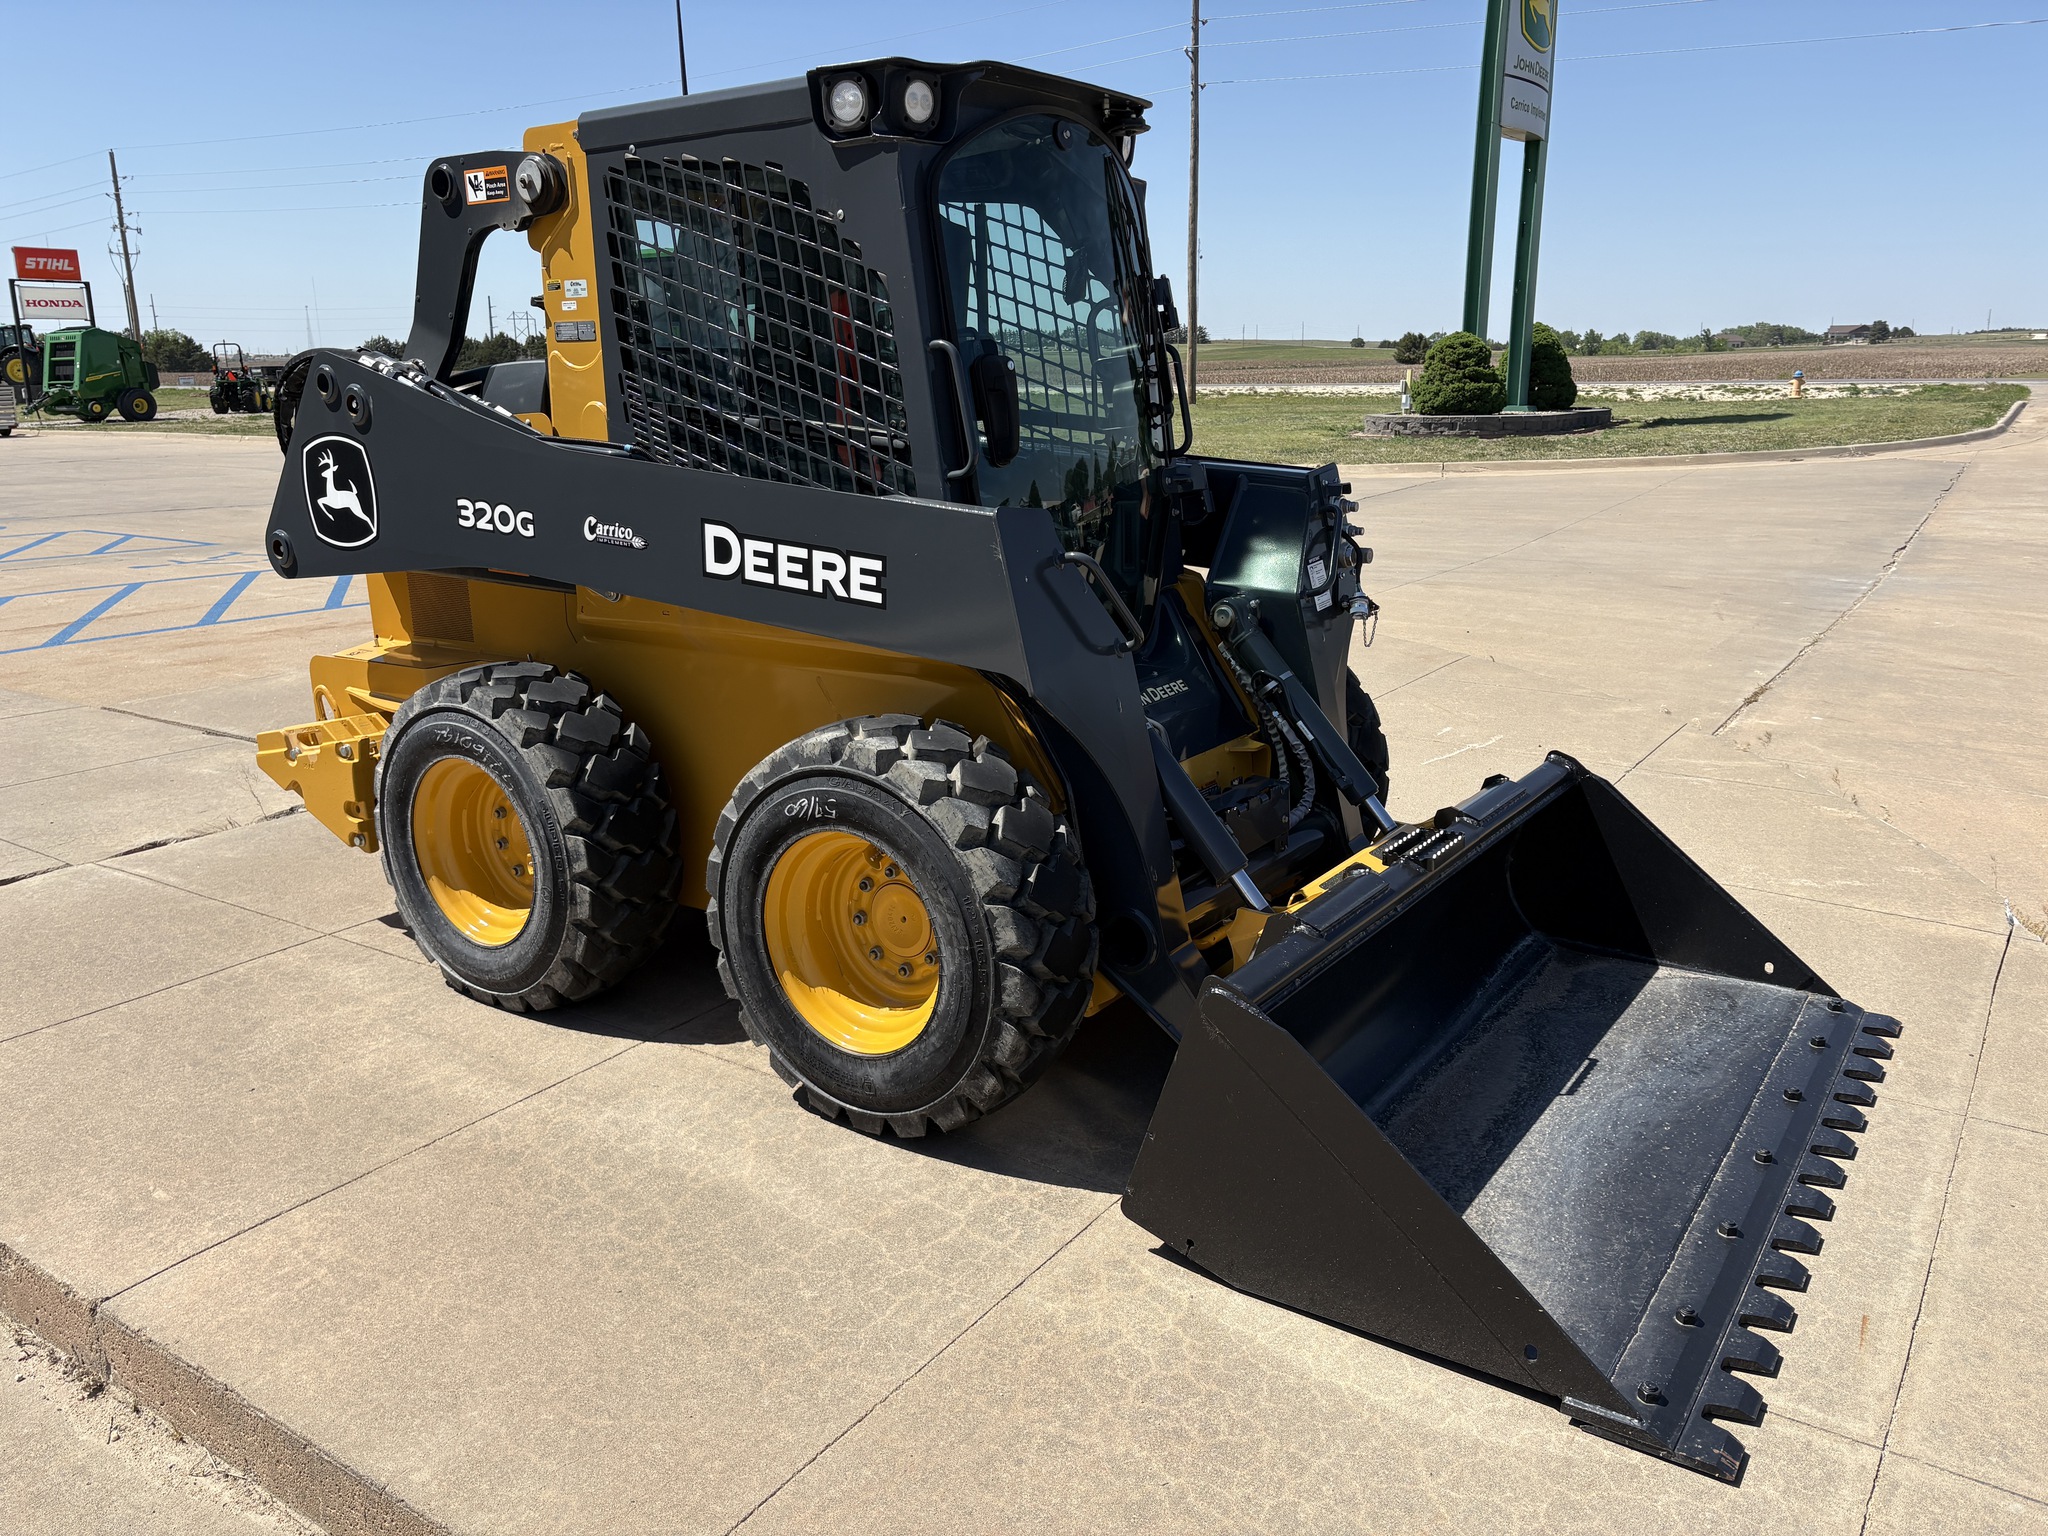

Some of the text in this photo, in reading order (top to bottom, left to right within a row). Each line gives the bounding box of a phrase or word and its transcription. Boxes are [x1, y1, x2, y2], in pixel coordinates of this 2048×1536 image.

[1514, 55, 1535, 74] JOHN
[1510, 97, 1530, 113] Carrico
[25, 257, 74, 271] STIHL
[25, 299, 84, 308] HONDA
[457, 498, 536, 538] 320G
[583, 515, 633, 542] Carrico
[597, 537, 632, 548] IMPLEMENT
[704, 523, 883, 604] DEERE
[1146, 679, 1189, 702] DEERE
